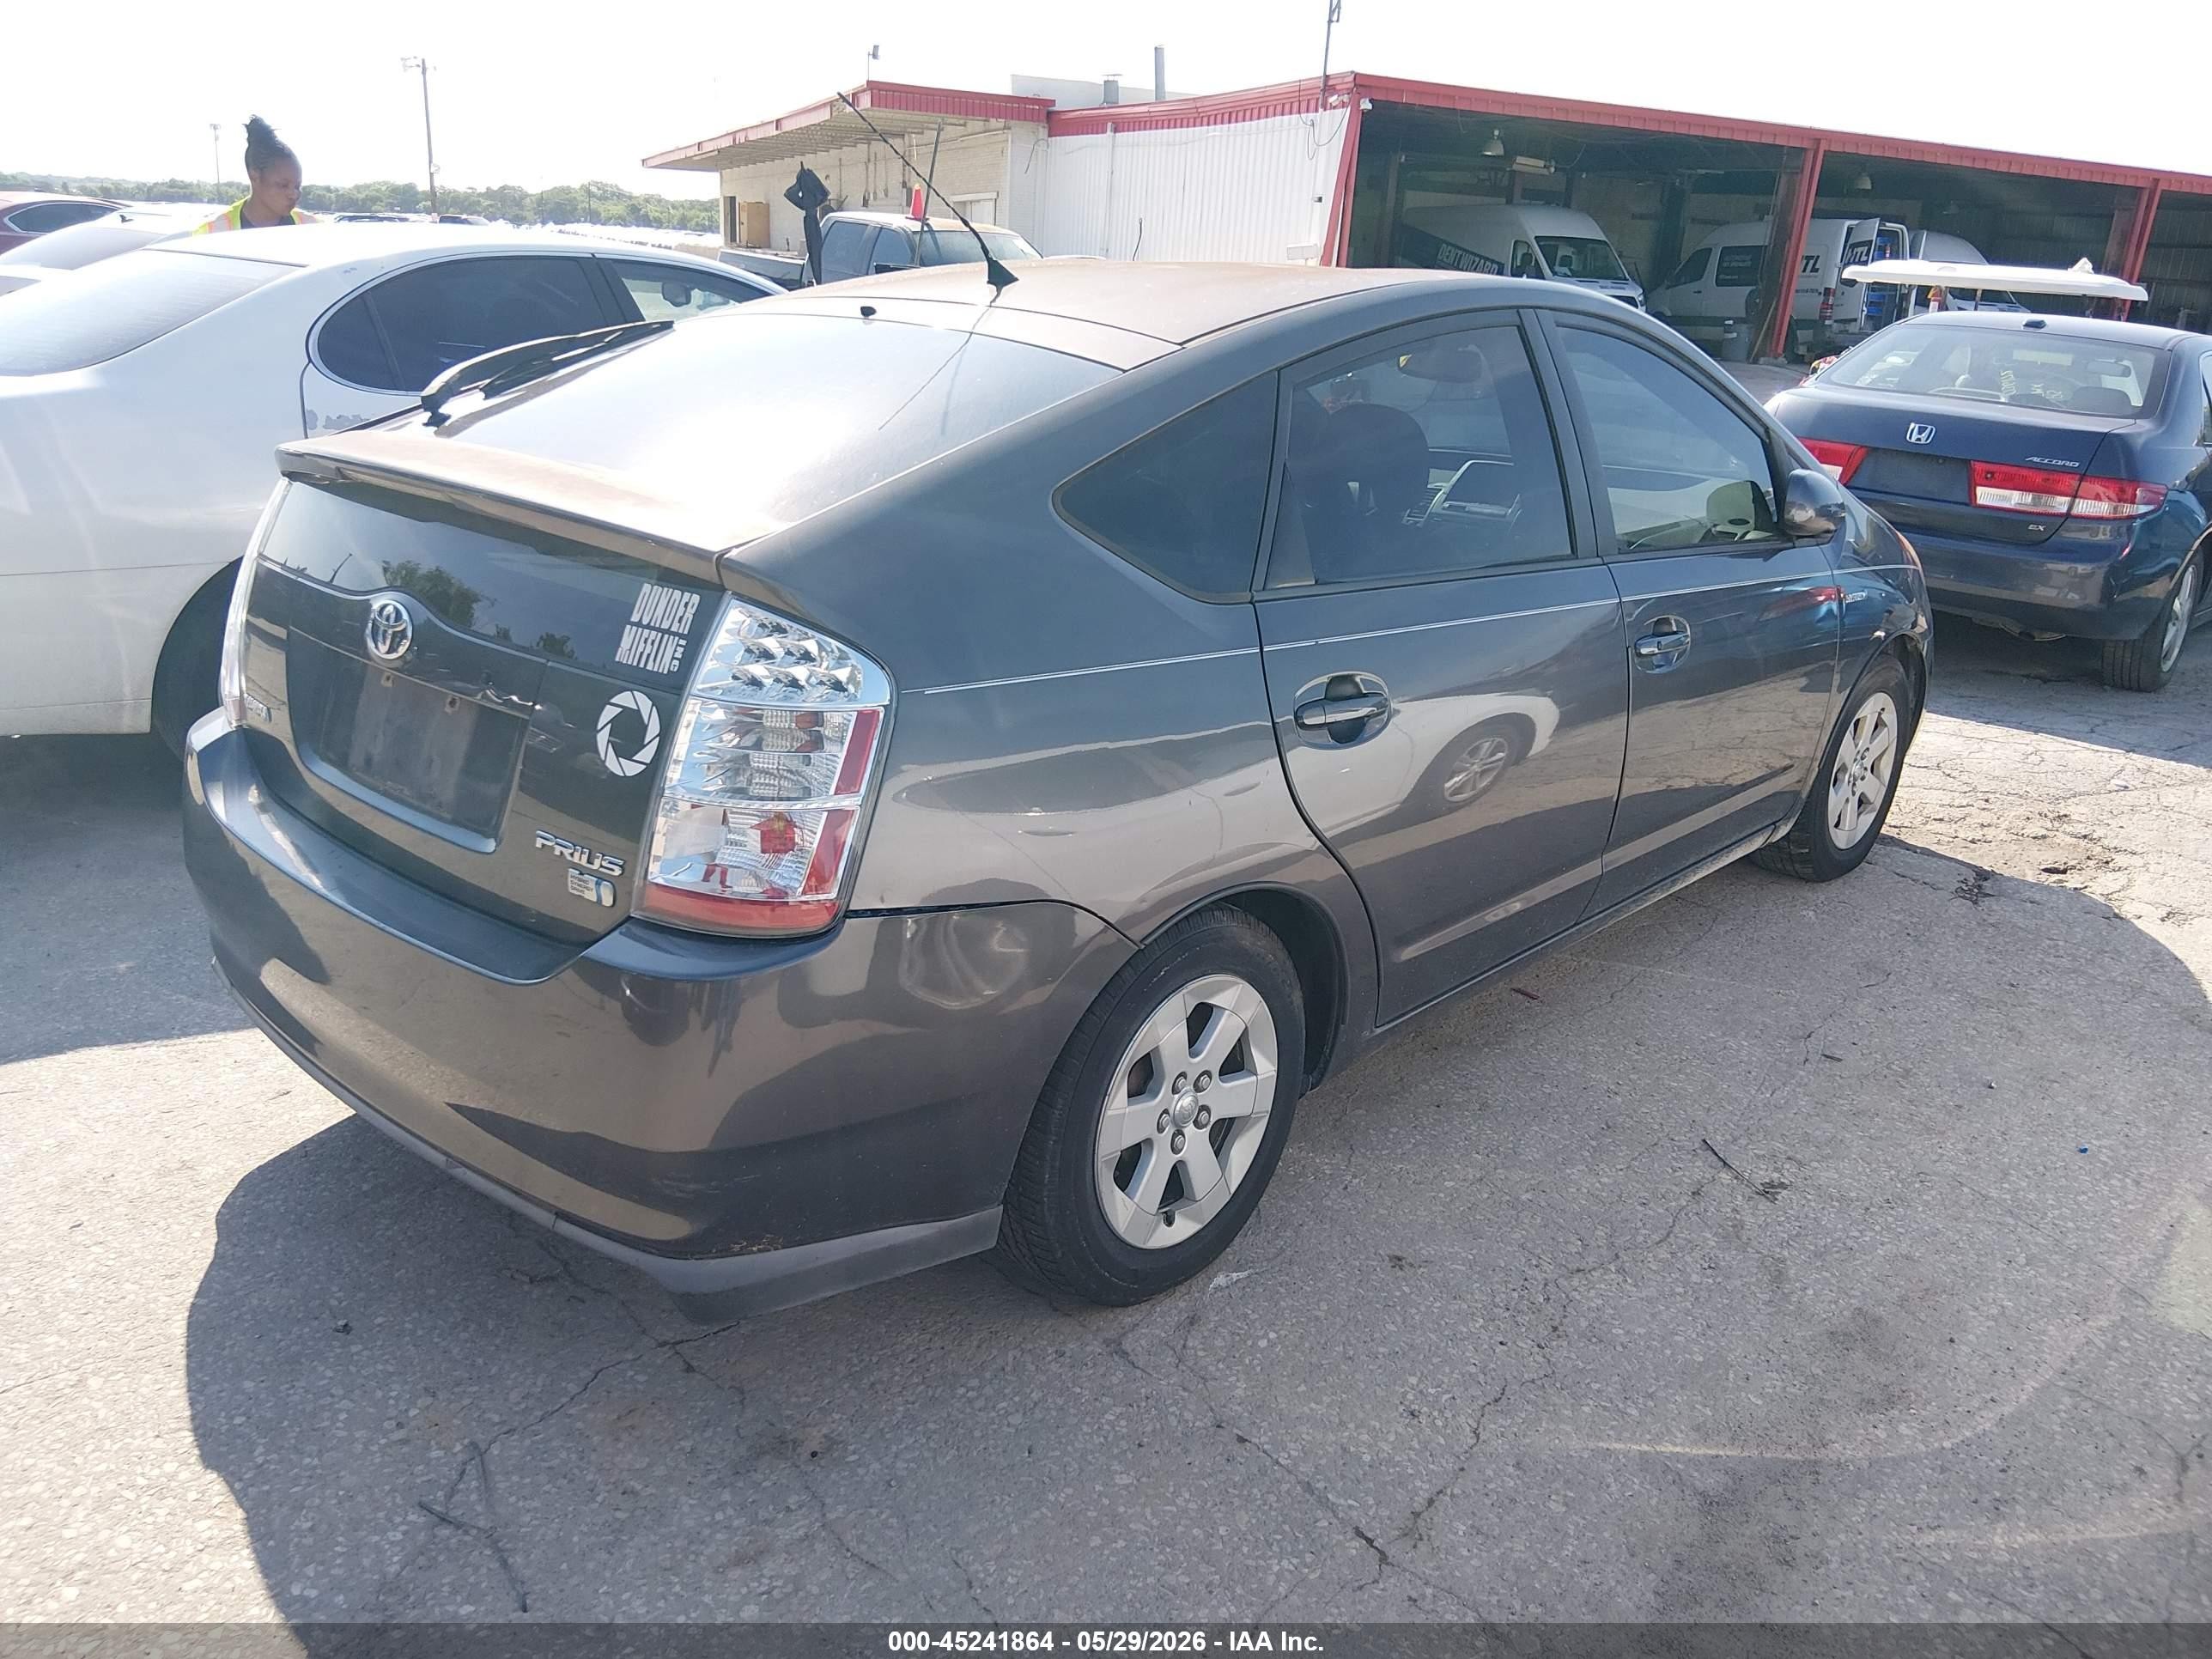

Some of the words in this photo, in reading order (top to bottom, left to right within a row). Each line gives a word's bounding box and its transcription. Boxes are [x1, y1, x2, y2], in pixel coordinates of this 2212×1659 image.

[2025, 456, 2080, 467] ACCORD
[630, 583, 701, 635] DUNDER
[615, 624, 679, 674] MIFFLIN
[670, 639, 688, 672] INC
[535, 830, 626, 877] PRIUS
